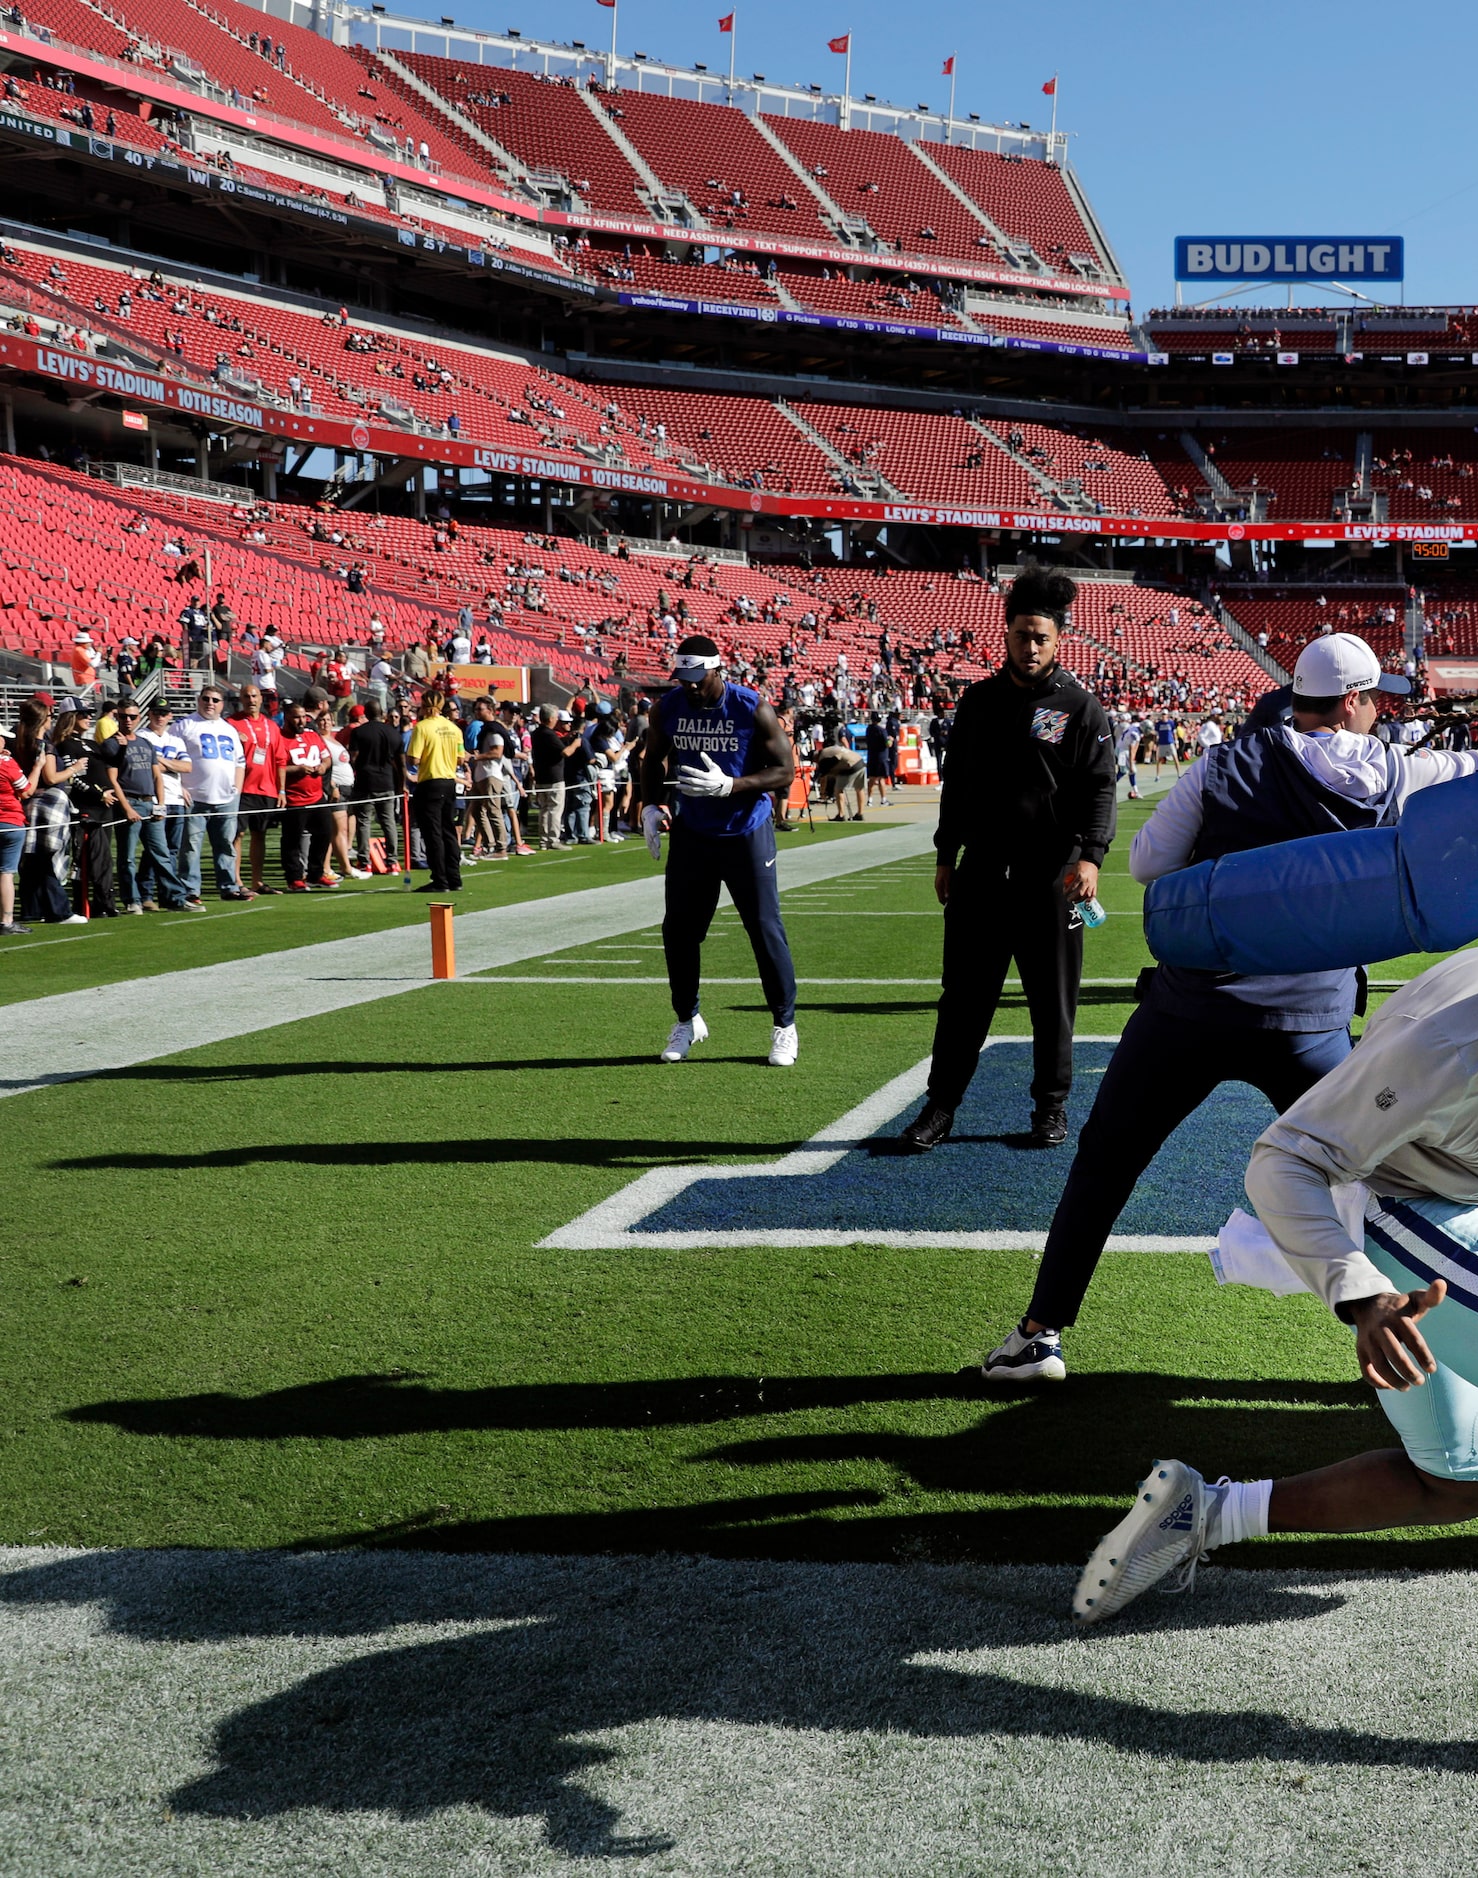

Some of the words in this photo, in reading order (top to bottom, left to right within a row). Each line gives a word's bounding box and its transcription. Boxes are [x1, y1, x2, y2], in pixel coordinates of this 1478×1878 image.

[124, 151, 142, 167] 40
[219, 178, 235, 193] 20
[286, 199, 303, 212] Field
[303, 204, 318, 216] Goal
[423, 237, 435, 251] 25
[491, 256, 504, 269] 20
[567, 214, 591, 227] FREE
[593, 218, 632, 232] XFINITY
[663, 228, 689, 240] NEED
[690, 231, 749, 248] ASSISTANCE?
[754, 239, 777, 251] TEXT
[778, 242, 828, 258] "SUPPORT"
[829, 249, 840, 260] TO
[841, 251, 863, 265] (573)
[863, 254, 903, 268] 549-HELP
[904, 258, 930, 272] (4357)
[938, 264, 973, 278] INCLUDE
[1000, 272, 1053, 288] DESCRIPTION,
[1054, 279, 1070, 290] AND
[1071, 281, 1111, 296] LOCATION.
[1187, 244, 1271, 273] BUD
[1274, 244, 1391, 273] LIGHT
[631, 296, 688, 312] yahoo/fantasy
[703, 303, 757, 318] RECEIVING
[793, 314, 821, 325] Pickens
[864, 322, 875, 331] TD
[886, 324, 906, 335] LONG
[941, 330, 989, 345] RECEIVING
[1102, 350, 1120, 360] LONG
[97, 365, 165, 402] STADIUM
[177, 388, 212, 414] 10TH
[212, 395, 263, 427] SEASON
[522, 457, 580, 480] STADIUM
[591, 469, 622, 489] 10TH
[622, 473, 668, 495] SEASON
[936, 509, 1000, 526] STADIUM
[1013, 514, 1048, 529] 10TH
[1048, 516, 1101, 532] SEASON
[1396, 526, 1464, 539] STADIUM
[1414, 543, 1448, 557] 95:00
[1346, 678, 1373, 690] COWBOYS
[677, 718, 734, 734] DALLAS
[1411, 729, 1420, 741] 17
[199, 733, 235, 761] 82
[673, 735, 739, 752] COWBOYS
[289, 745, 321, 766] 54
[1159, 1494, 1192, 1530] adidas
